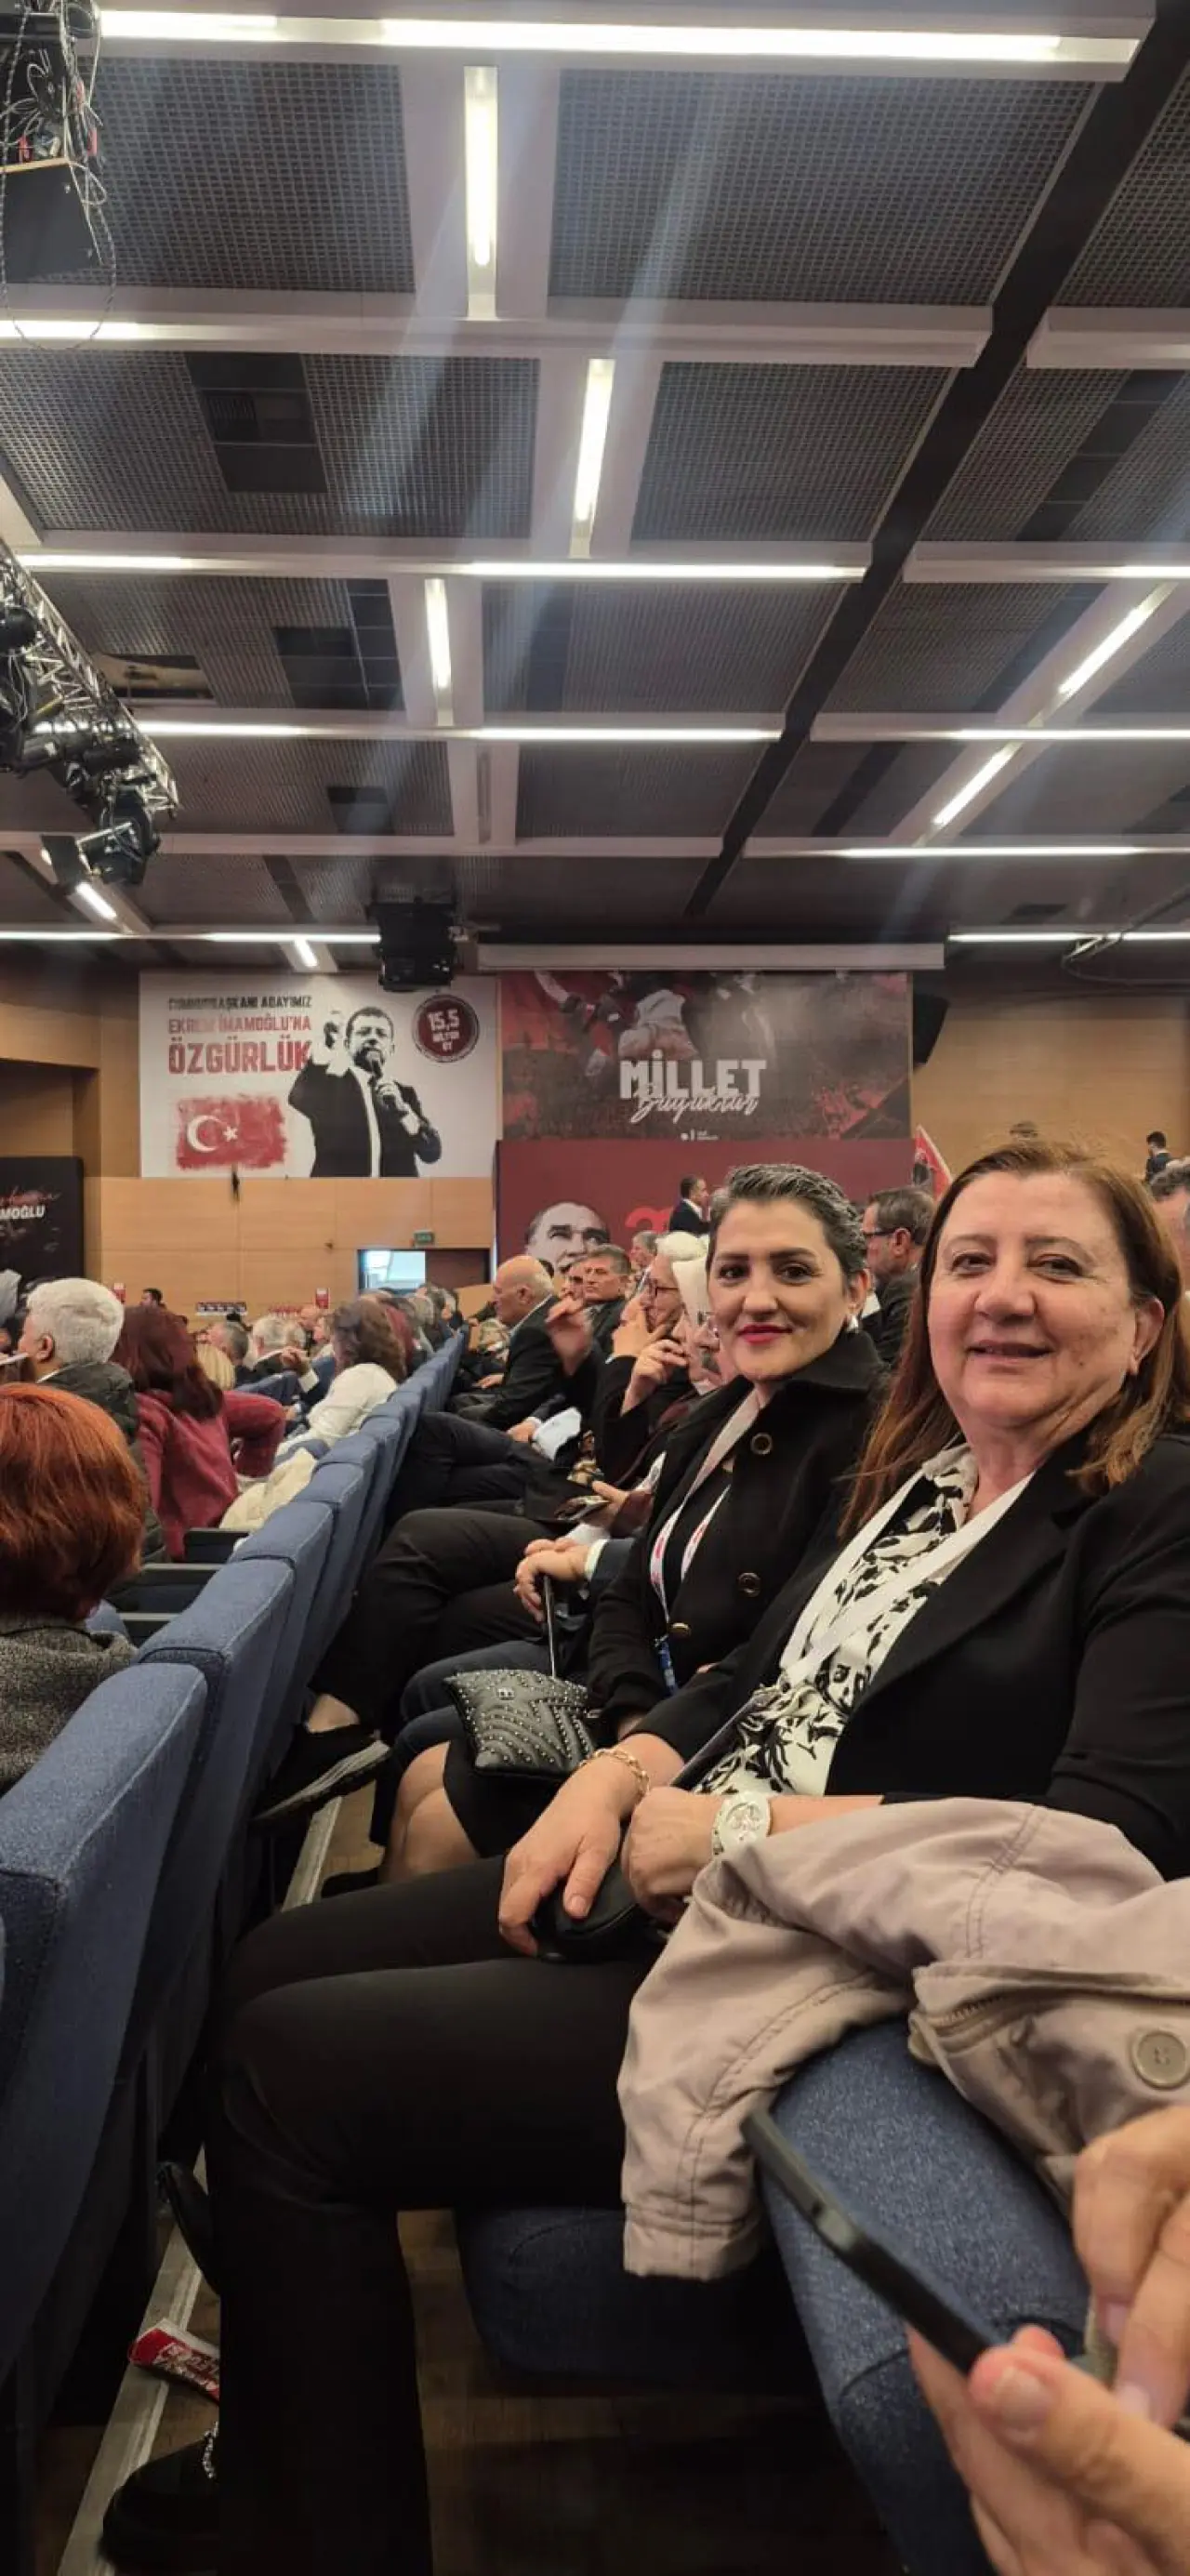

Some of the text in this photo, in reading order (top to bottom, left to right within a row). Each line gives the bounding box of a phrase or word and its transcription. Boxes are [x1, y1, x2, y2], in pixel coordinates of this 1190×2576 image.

[168, 1017, 216, 1035] EKR
[428, 1009, 460, 1031] 15,5
[168, 1035, 312, 1075] ÖZGÜRLÜK
[619, 1050, 767, 1099] MİLLET
